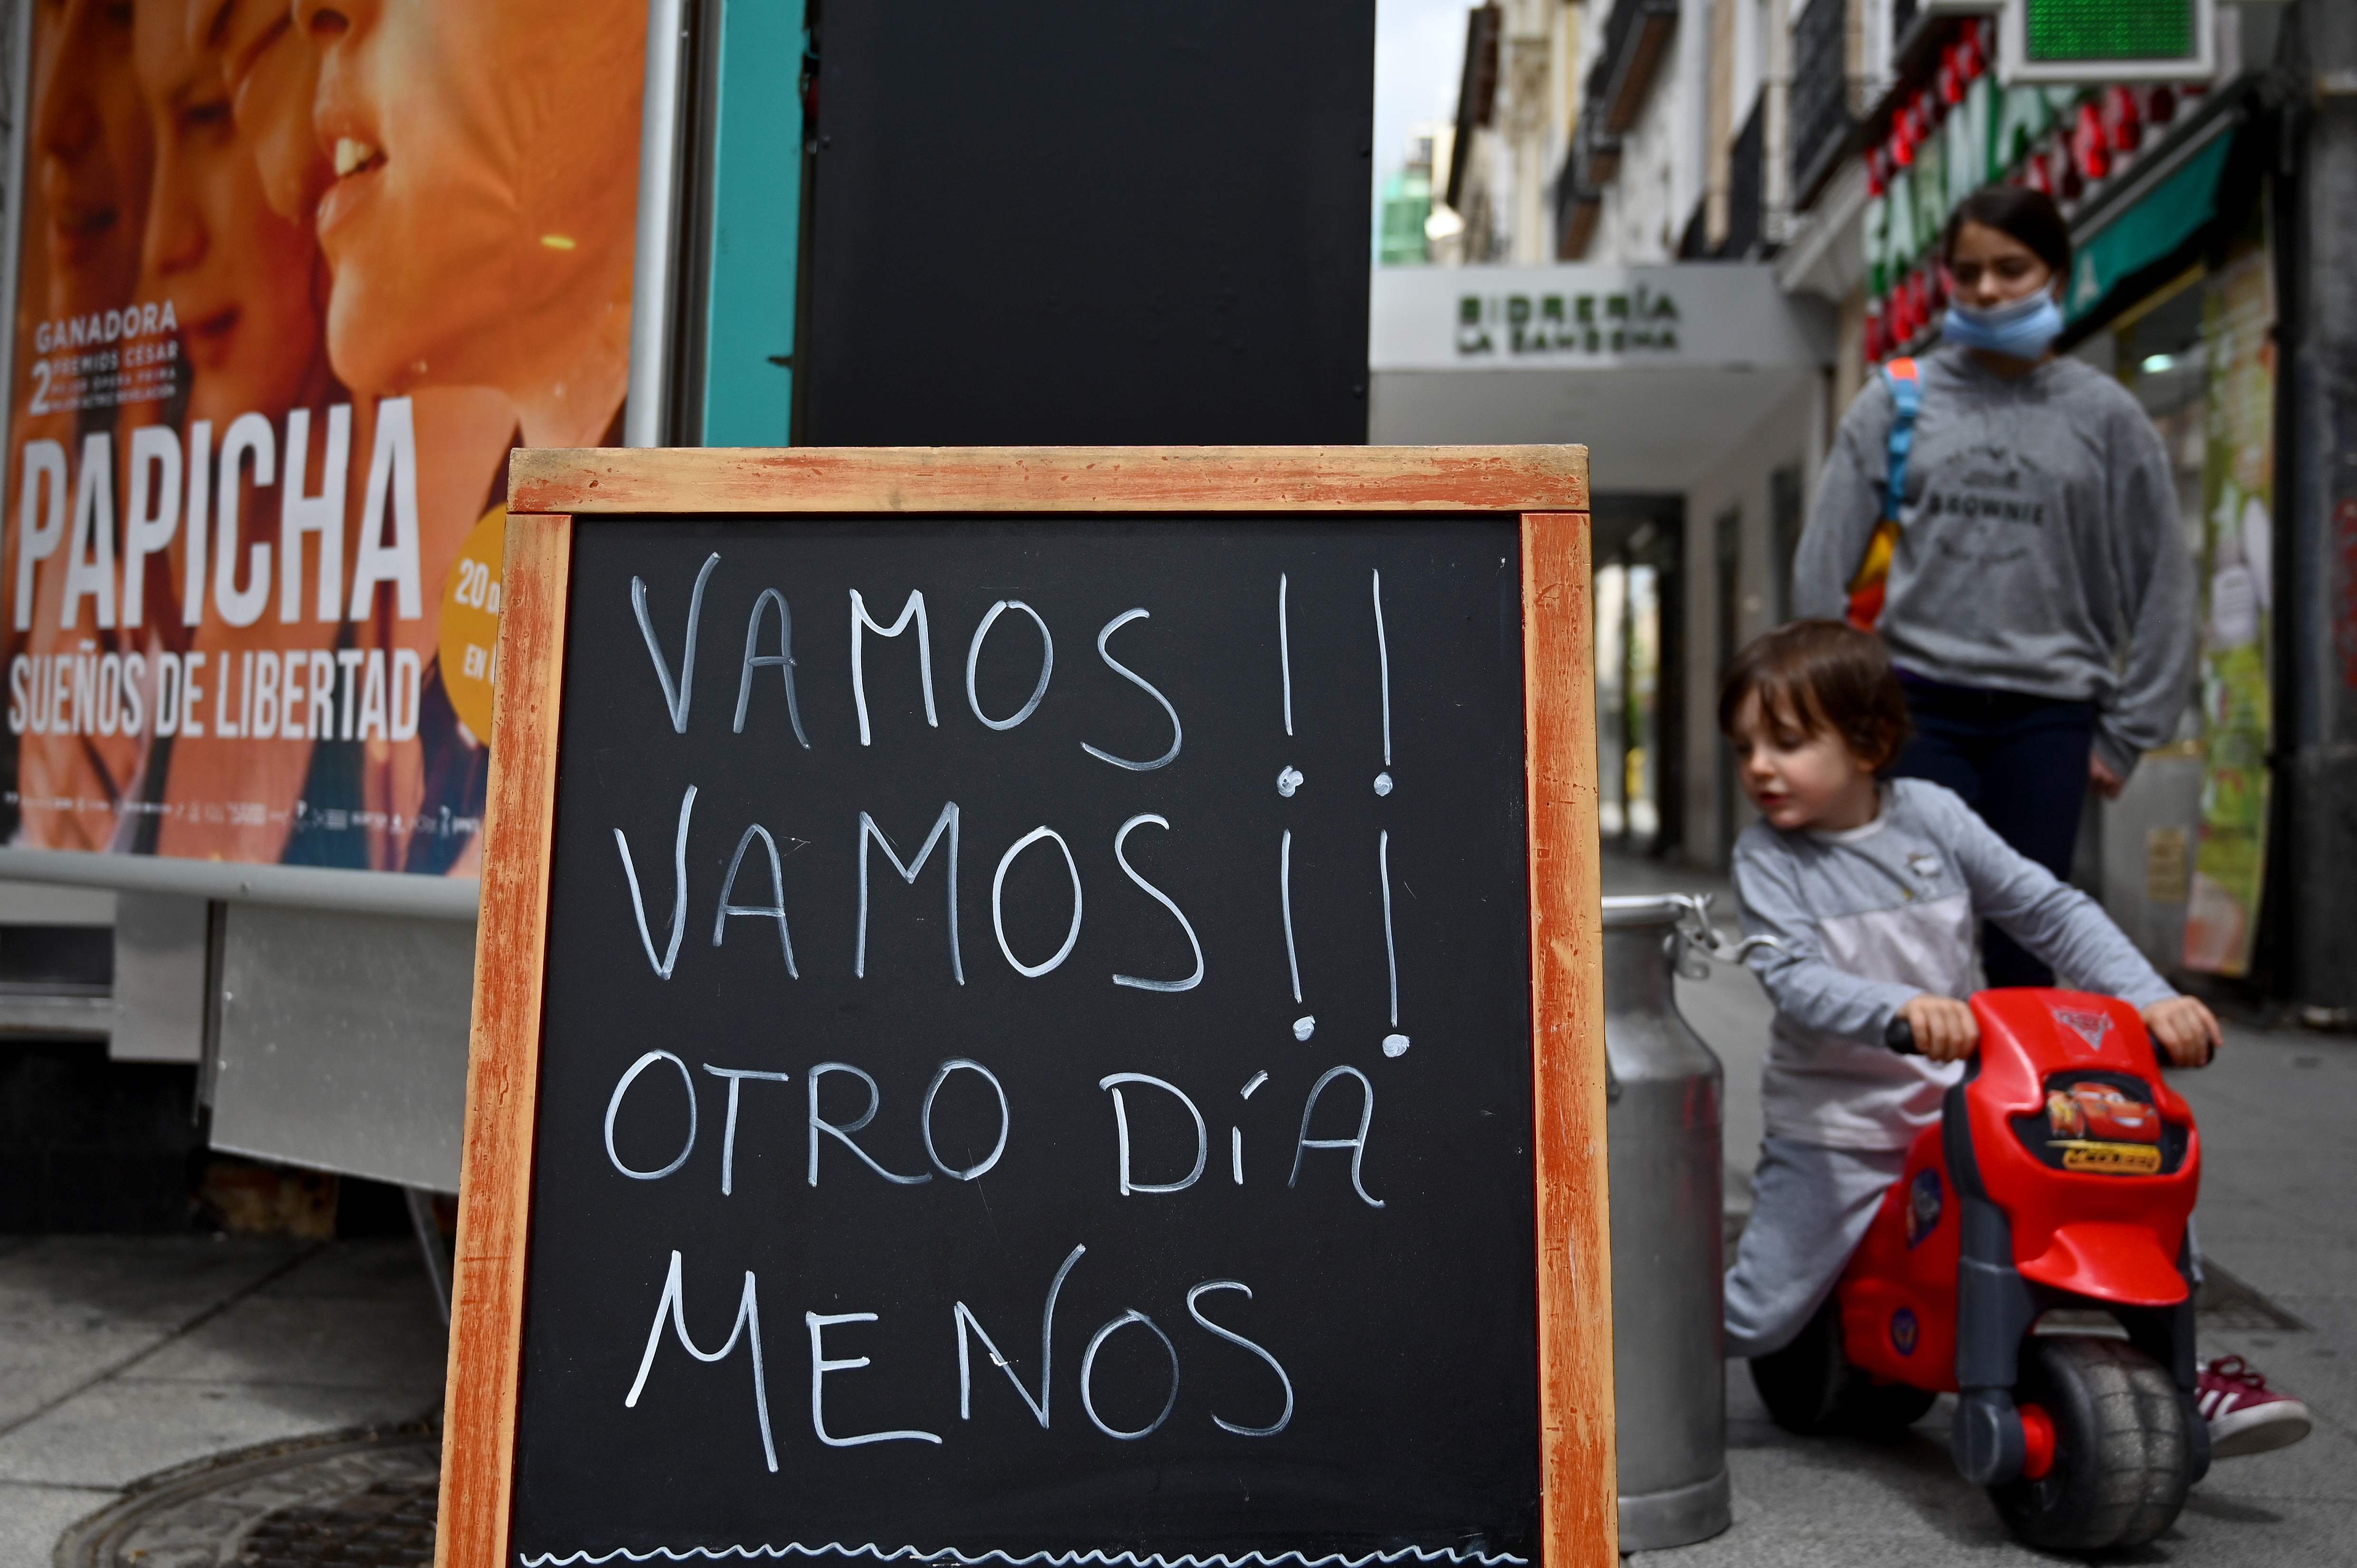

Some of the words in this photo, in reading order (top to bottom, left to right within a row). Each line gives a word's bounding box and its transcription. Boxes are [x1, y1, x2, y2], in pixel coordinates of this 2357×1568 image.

[29, 360, 51, 416] 2
[34, 299, 178, 354] GANADORA
[14, 396, 422, 631] PAPICHA
[454, 558, 489, 609] 20
[9, 638, 145, 736] SUEÑOS
[155, 650, 206, 738] DE
[216, 647, 422, 742] LIBERTAD
[463, 643, 487, 681] EN
[631, 552, 1182, 771] VAMOS
[613, 784, 1205, 993] VAMOS
[605, 1049, 1013, 1196] OTRO
[625, 1243, 1293, 1472] MENOS
